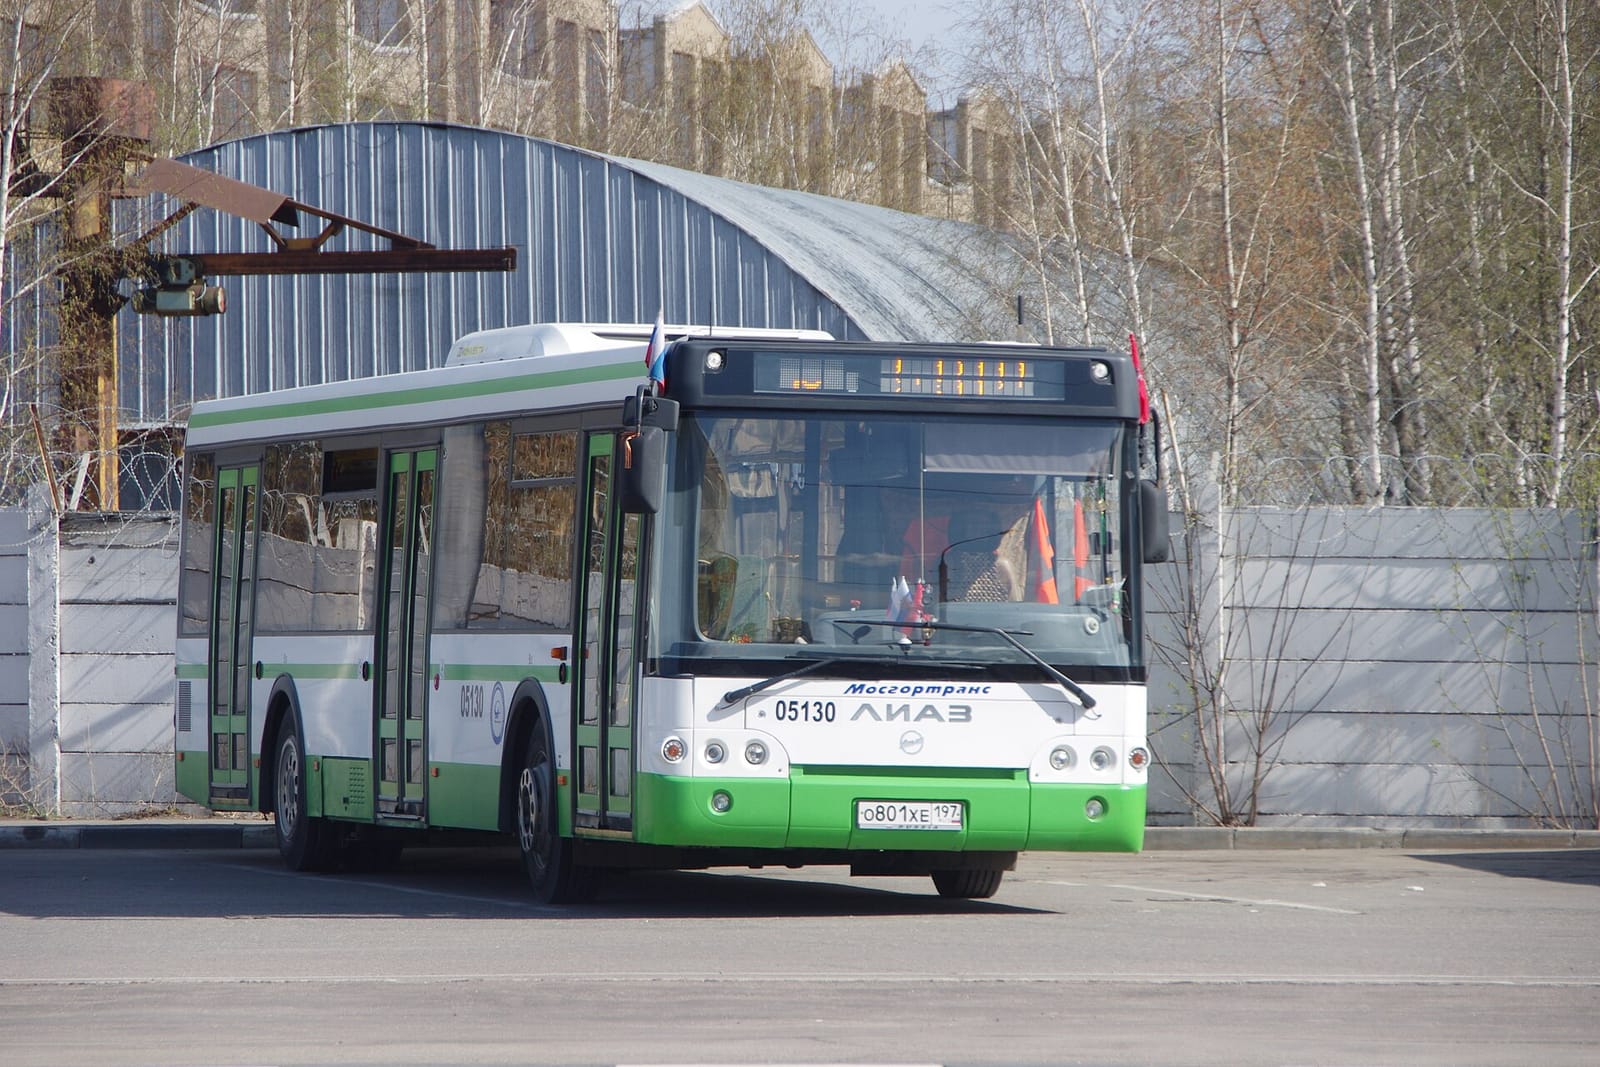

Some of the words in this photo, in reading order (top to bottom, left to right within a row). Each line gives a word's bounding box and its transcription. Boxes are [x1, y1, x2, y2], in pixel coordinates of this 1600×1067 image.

[844, 683, 991, 696] Мосгортранс
[460, 685, 484, 718] 05130
[776, 700, 836, 722] 05130
[850, 703, 972, 722] ЛИАЗ
[934, 805, 957, 818] 197
